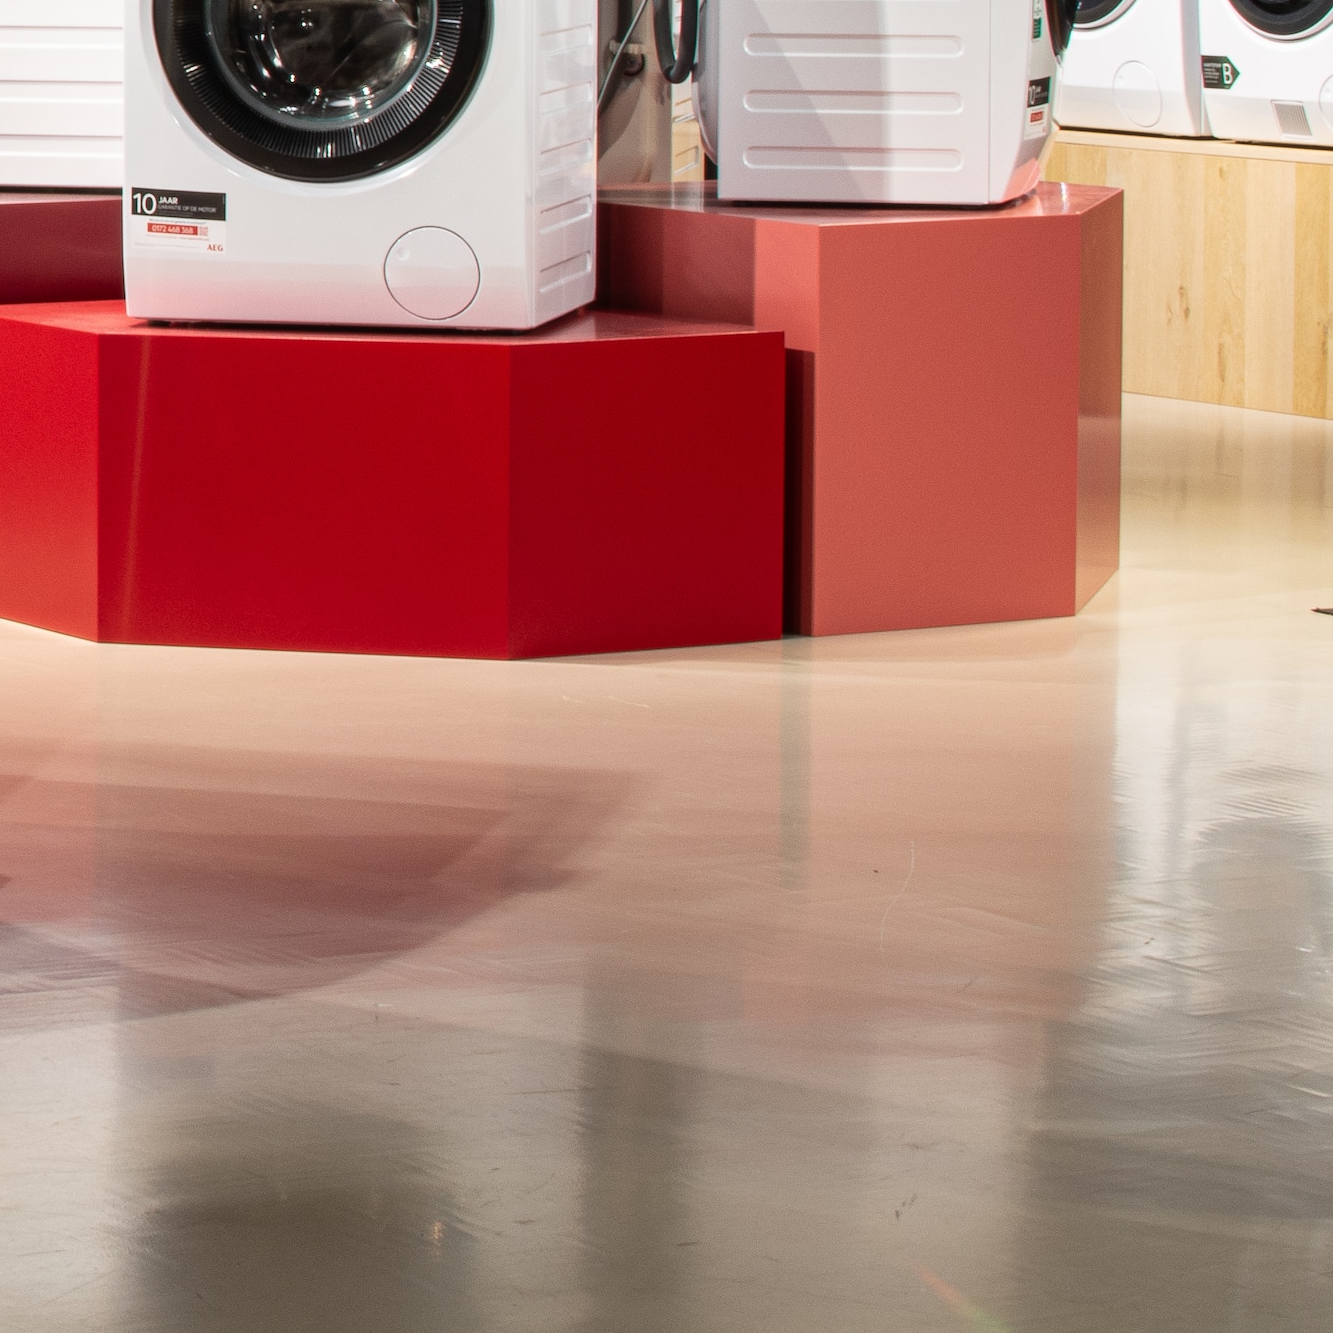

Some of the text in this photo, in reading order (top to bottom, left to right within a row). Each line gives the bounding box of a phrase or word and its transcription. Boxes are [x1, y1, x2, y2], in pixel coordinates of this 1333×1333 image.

[1222, 63, 1233, 85] B
[133, 192, 157, 215] 10
[158, 196, 178, 204] JAAR
[207, 244, 223, 252] AEG
